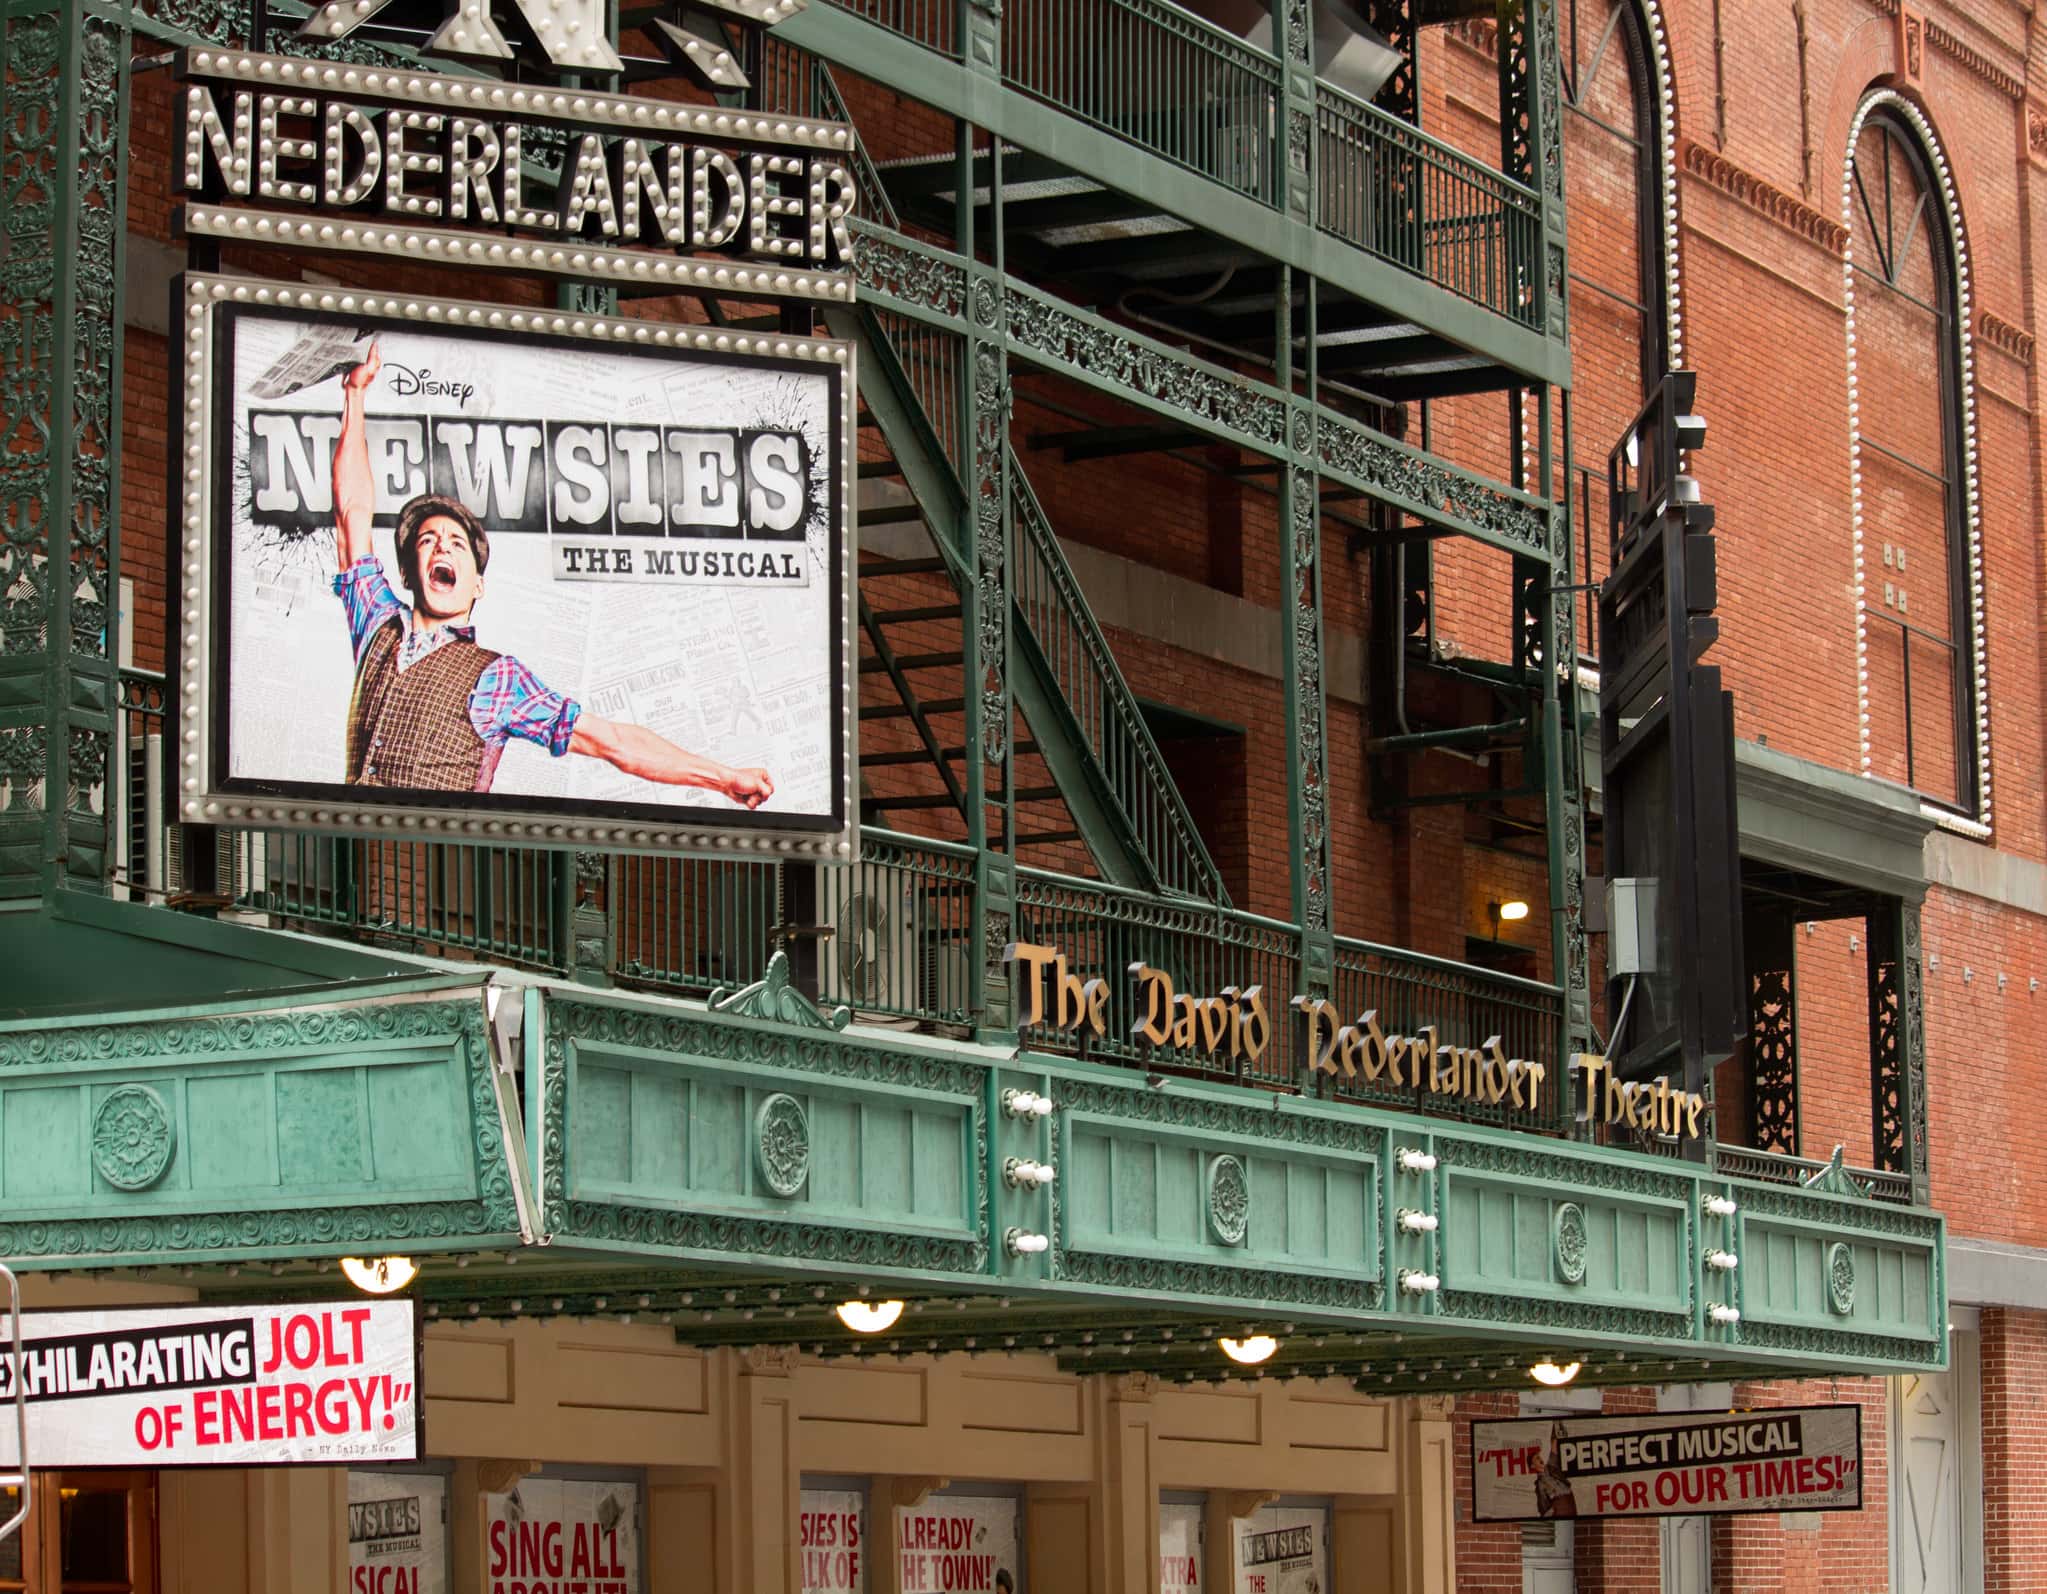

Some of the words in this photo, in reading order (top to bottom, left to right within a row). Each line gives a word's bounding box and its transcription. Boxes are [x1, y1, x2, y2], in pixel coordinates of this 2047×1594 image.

[182, 84, 856, 263] NEDERLANDER
[253, 415, 803, 531] NEWSIES
[562, 547, 633, 574] THE
[644, 550, 801, 578] MUSICAL
[1005, 942, 1110, 1035] The
[1127, 960, 1270, 1061] David
[1292, 995, 1545, 1112] Nederlander
[1568, 1053, 1703, 1140] Theatre
[263, 1308, 372, 1373] JOLT
[134, 1405, 183, 1451] OF
[194, 1375, 411, 1447] ENERGY!"
[1559, 1432, 1673, 1472] PERFECT
[1678, 1420, 1799, 1460] MUSICAL
[1596, 1481, 1649, 1513] FOR
[1654, 1467, 1728, 1507] OUR
[1732, 1455, 1857, 1499] TIMES!"
[488, 1520, 562, 1577] SING
[571, 1521, 625, 1578] ALL
[842, 1513, 858, 1547] IS
[350, 1565, 418, 1594] SICAL
[835, 1552, 858, 1589] OF
[898, 1554, 926, 1591] HE
